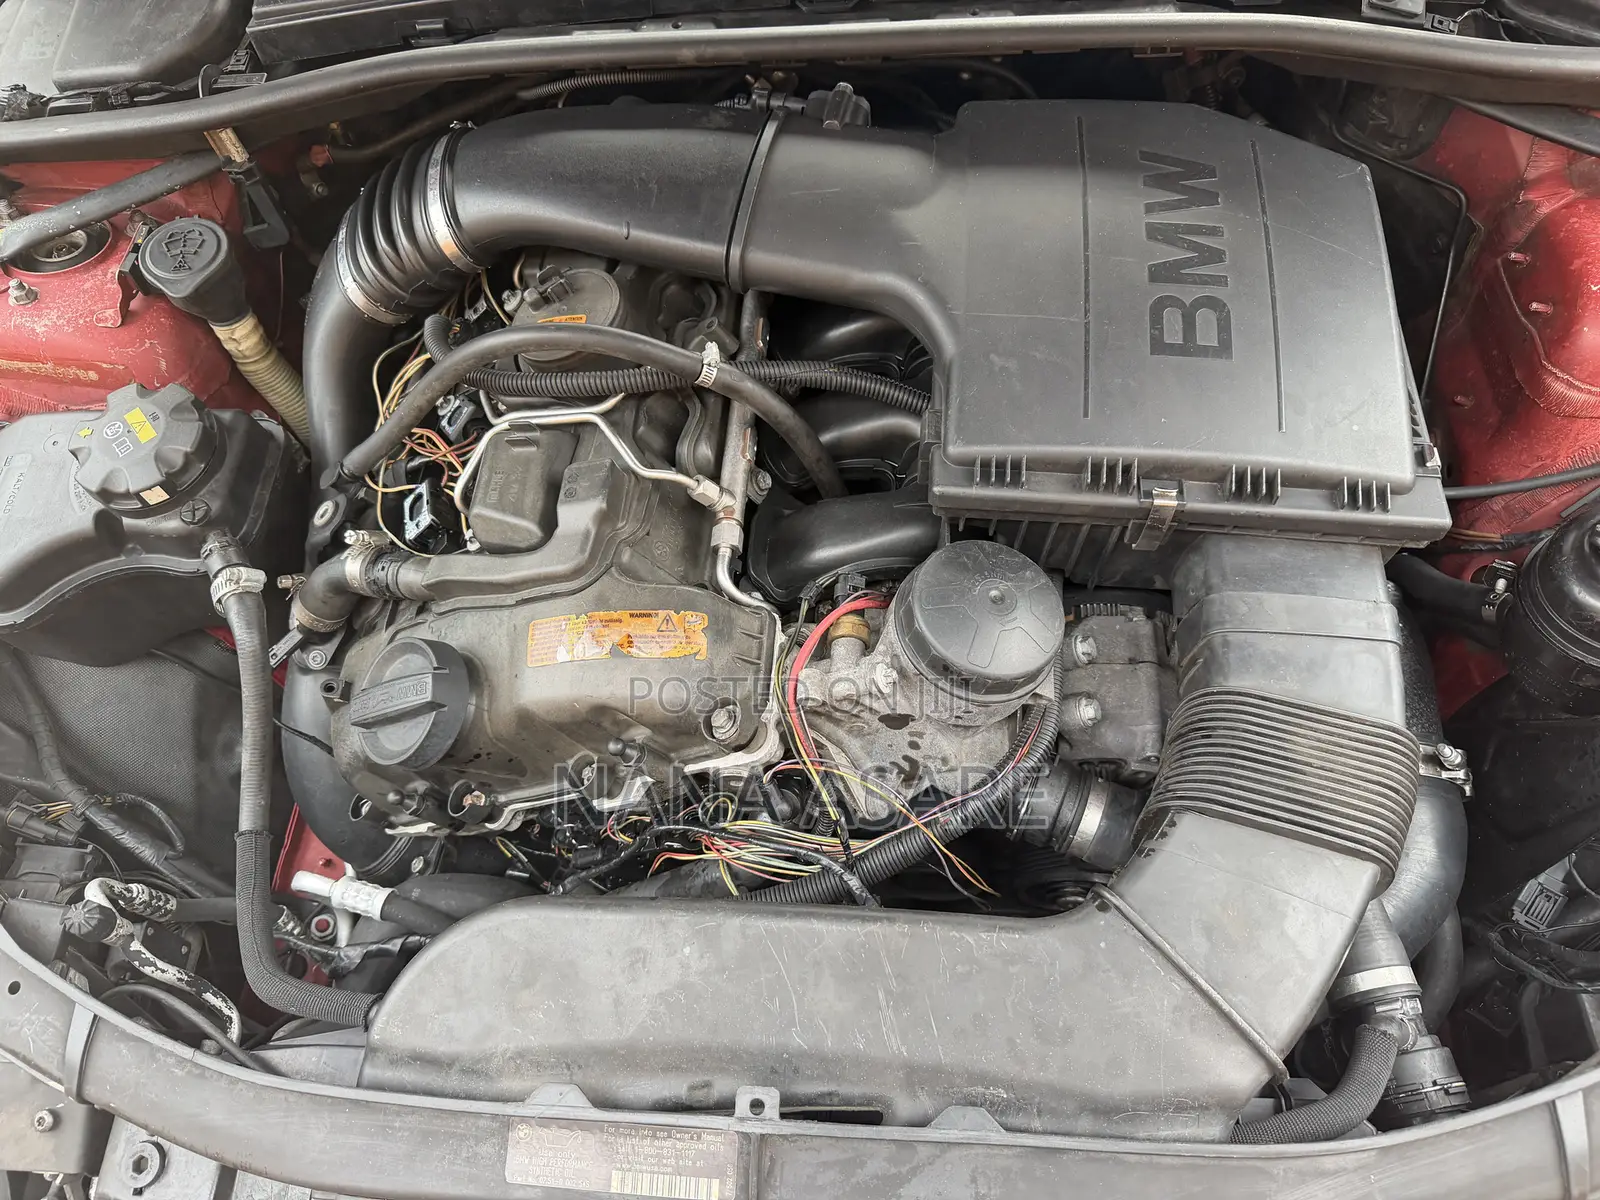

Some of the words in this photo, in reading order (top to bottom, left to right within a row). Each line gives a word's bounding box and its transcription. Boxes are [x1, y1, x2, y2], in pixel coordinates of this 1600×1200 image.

[1138, 150, 1234, 360] BMW
[604, 1124, 616, 1133] For
[656, 1130, 668, 1138] see
[671, 1129, 698, 1140] Owner's
[701, 1132, 725, 1142] Manual
[675, 1141, 707, 1151] approved
[557, 1150, 576, 1160] only
